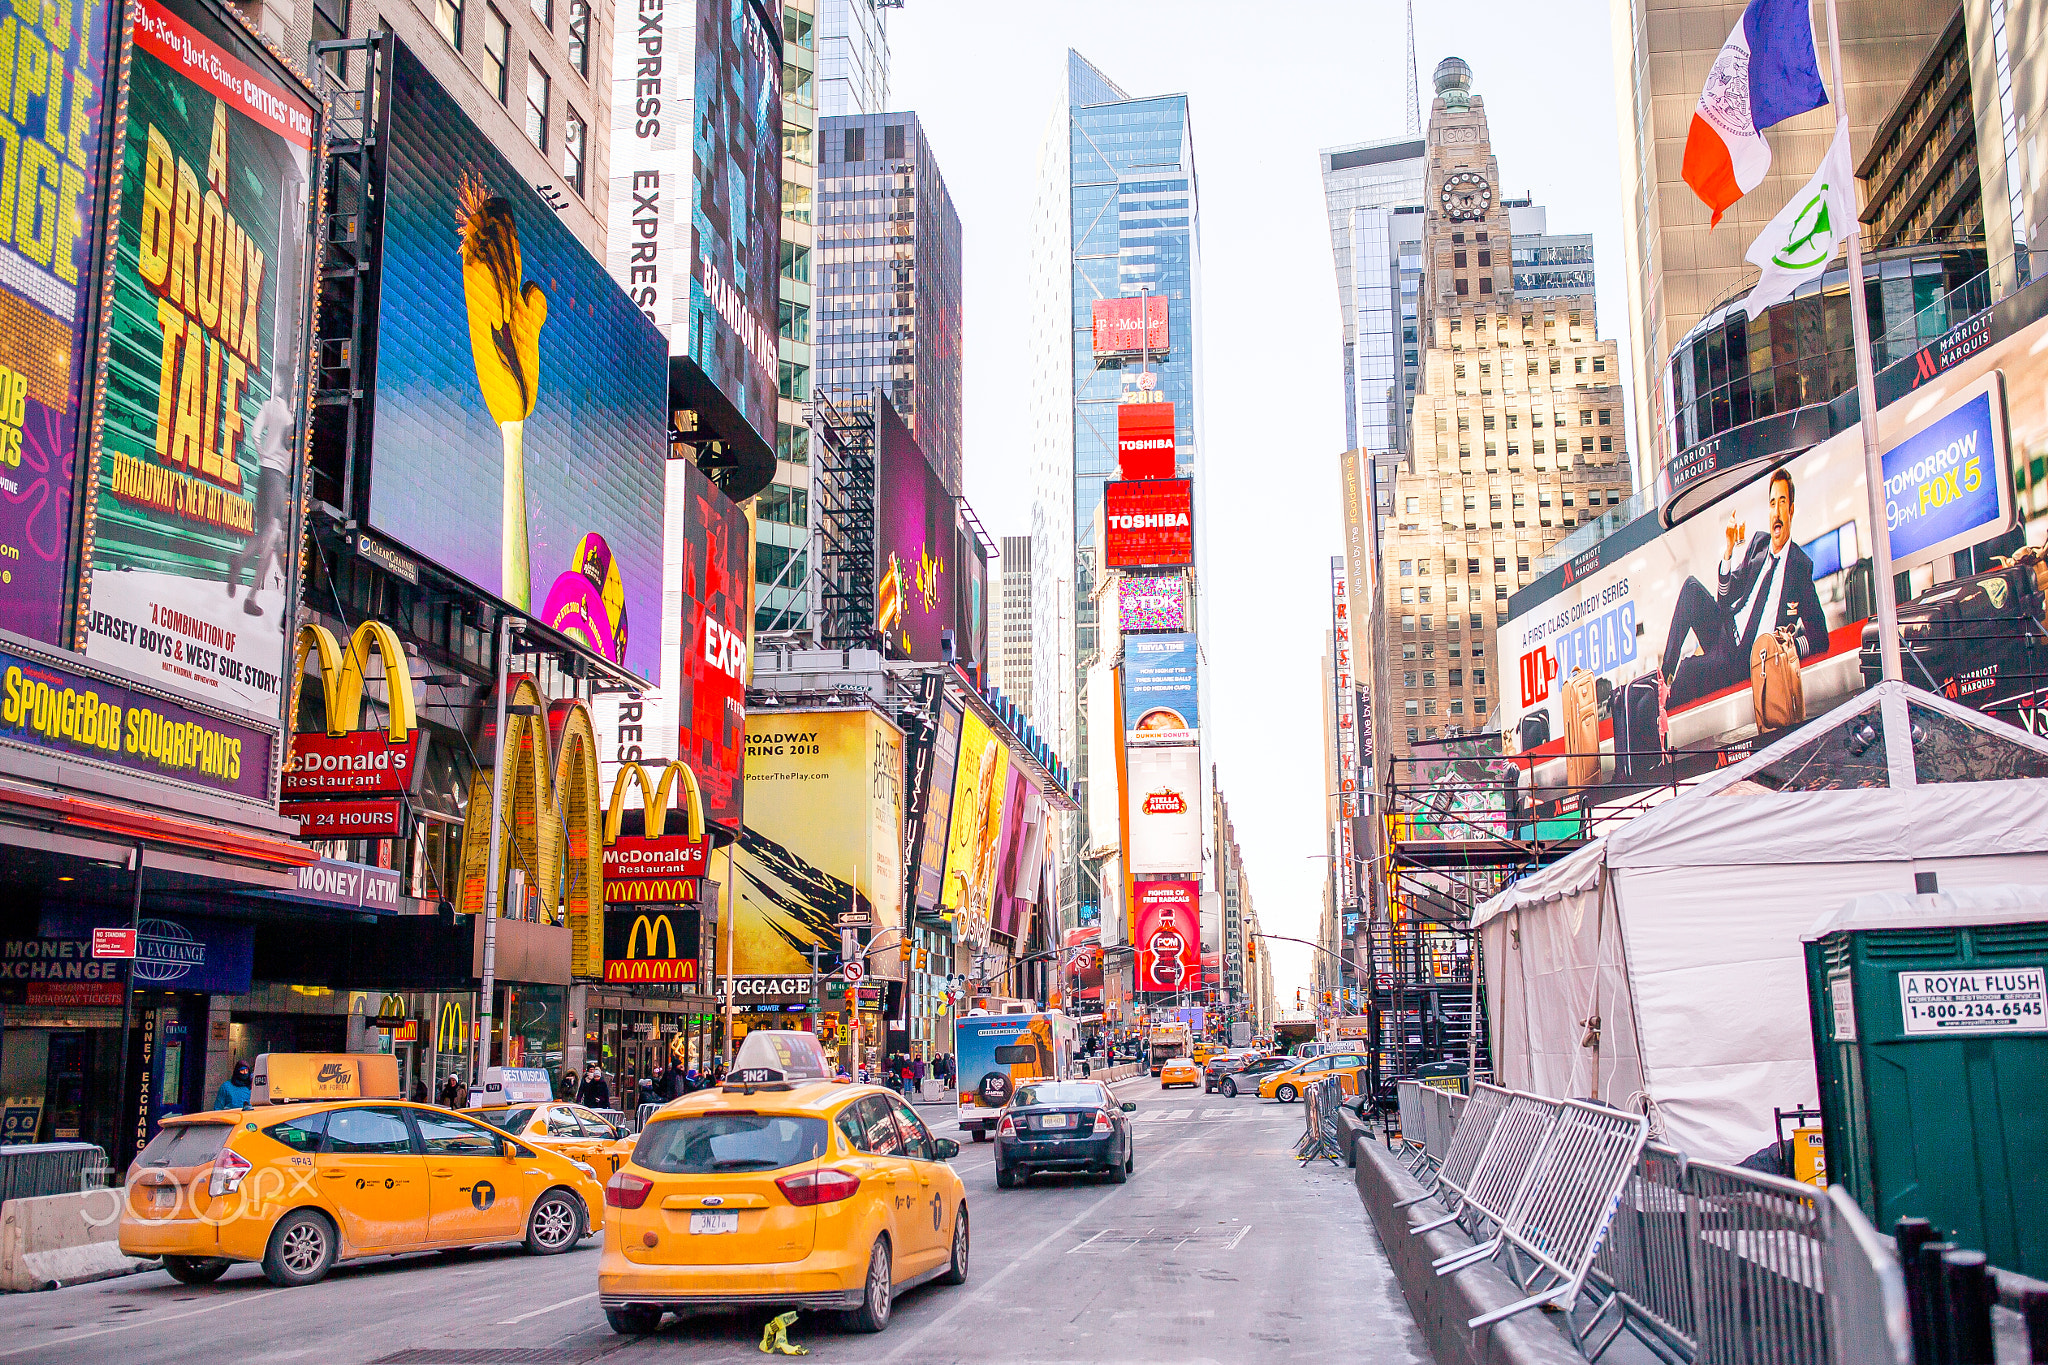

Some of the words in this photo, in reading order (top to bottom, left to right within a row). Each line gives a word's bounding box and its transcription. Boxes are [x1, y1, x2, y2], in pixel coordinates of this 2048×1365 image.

[133, 5, 155, 32] The
[156, 18, 181, 50] New
[182, 36, 210, 74] York
[210, 54, 242, 94] Times
[243, 79, 287, 123] CRITICS'
[289, 106, 312, 138] PICK
[207, 98, 228, 196] A
[139, 122, 264, 366] BRONX
[630, 169, 660, 325] EXPRES
[703, 253, 756, 355] BRANDON
[1940, 310, 1994, 350] MARRIOTT
[1940, 330, 1990, 368] MARQUIS
[156, 297, 246, 485] TALE
[1128, 390, 1164, 403] 2018
[1119, 439, 1173, 450] TOSHIBA
[1673, 440, 1721, 471] MARRIOTT
[1674, 456, 1716, 487] MARQUIS
[1884, 430, 1978, 500] TOMORROW
[112, 451, 186, 509] BROADWAY'S
[185, 480, 207, 517] NEW
[207, 487, 223, 521] HIT
[222, 492, 254, 531] MUSICAL
[1918, 470, 1963, 516] FOX
[1964, 458, 1982, 493] 5
[1109, 512, 1189, 529] TOSHIBA
[1352, 527, 1360, 543] the
[1352, 545, 1361, 559] by
[1575, 546, 1601, 567] MARRIOTT
[1575, 558, 1599, 577] MARQUIS
[1353, 579, 1362, 596] We
[1136, 596, 1181, 609] TDK
[1522, 633, 1528, 648] A
[1528, 624, 1546, 644] FIRST
[1549, 610, 1570, 635] CLASS
[1571, 595, 1600, 623] COMEDY
[1602, 578, 1629, 606] SERIES
[161, 606, 223, 651] COMBINATION
[226, 631, 236, 652] OF
[1337, 581, 1349, 688] ERNST
[89, 610, 137, 645] JERSEY
[140, 628, 172, 657] BOYS
[174, 640, 183, 661] &
[186, 643, 217, 672] WEST
[219, 655, 243, 682] SIDE
[705, 615, 746, 691] EXPR
[1138, 643, 1164, 651] TRIVIA
[1165, 642, 1184, 650] TIME
[1522, 650, 1547, 702] LA
[1558, 605, 1633, 680] VEGAS
[1362, 686, 1370, 702] the
[1961, 678, 1994, 693] MARQUIS
[1363, 703, 1371, 717] by
[1340, 714, 1352, 729] &
[745, 733, 818, 744] ROADWAY
[1728, 740, 1752, 754] MARRIOTT
[744, 746, 784, 756] RING
[790, 745, 820, 755] 2018
[875, 729, 899, 778] HARRY
[1365, 740, 1373, 756] We
[1728, 751, 1750, 762] MARQUIS
[292, 751, 408, 771] cDonald's
[287, 774, 381, 787] Restaurant
[745, 772, 829, 782] PotterThePlay.com
[874, 762, 901, 810] POTTER
[317, 813, 335, 825] 24
[340, 812, 393, 824] HOURS
[603, 847, 702, 864] McDonald's
[619, 863, 684, 874] Restaurant
[299, 867, 358, 896] MONEY
[366, 878, 397, 903] ATM
[5, 941, 92, 957] MONEY
[1157, 938, 1178, 946] POM
[148, 943, 206, 961] EXCHANGE
[1907, 978, 1919, 994] A
[1925, 977, 1979, 993] ROYAL
[1986, 974, 2040, 991] FLUSH
[28, 994, 81, 1003] BROADWAY
[83, 994, 121, 1003] TICKETS
[1911, 1002, 2042, 1018] 1-800-234-6545
[634, 1023, 652, 1032] EXPRESS
[661, 1023, 678, 1032] EXPRESS
[143, 1010, 155, 1064] MONEY
[322, 1063, 342, 1074] MIKE
[503, 1070, 520, 1080] BEST
[520, 1070, 548, 1082] MUSICAL
[741, 1070, 768, 1082] 3N21
[335, 1074, 352, 1084] OBJ
[137, 1072, 150, 1153] EXCHANG
[291, 1157, 312, 1166] 9P43
[702, 1215, 721, 1228] 3N21
